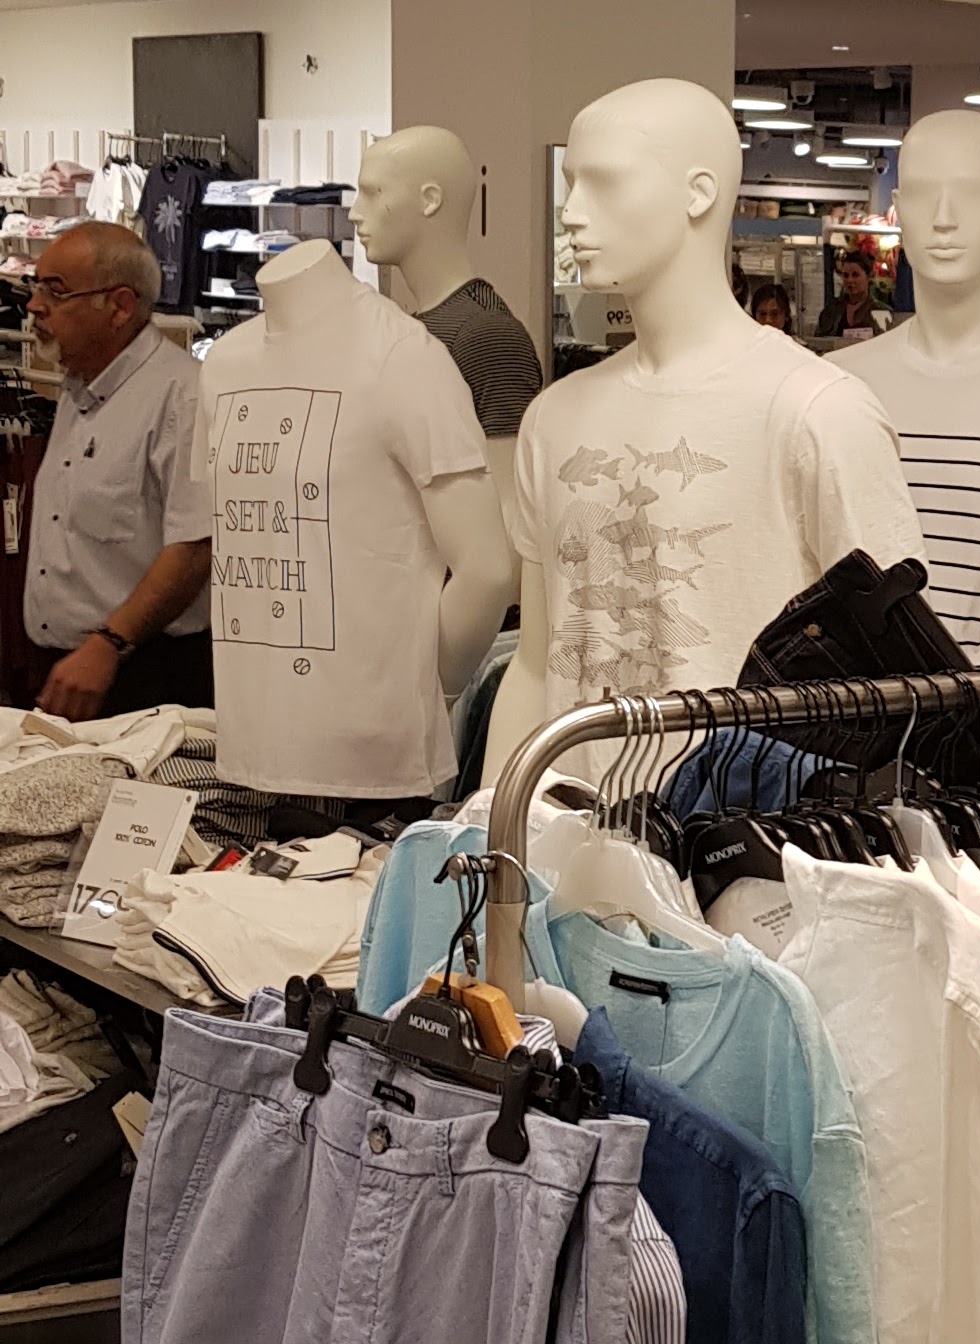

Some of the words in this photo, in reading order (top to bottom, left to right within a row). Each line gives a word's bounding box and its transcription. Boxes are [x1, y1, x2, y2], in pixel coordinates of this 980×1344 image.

[228, 442, 280, 474] JEU
[225, 500, 268, 532] SET
[272, 501, 289, 533] &
[211, 555, 307, 592] MATCH
[704, 841, 747, 865] MONOPRIX
[408, 1014, 450, 1039] MONOPRIX
